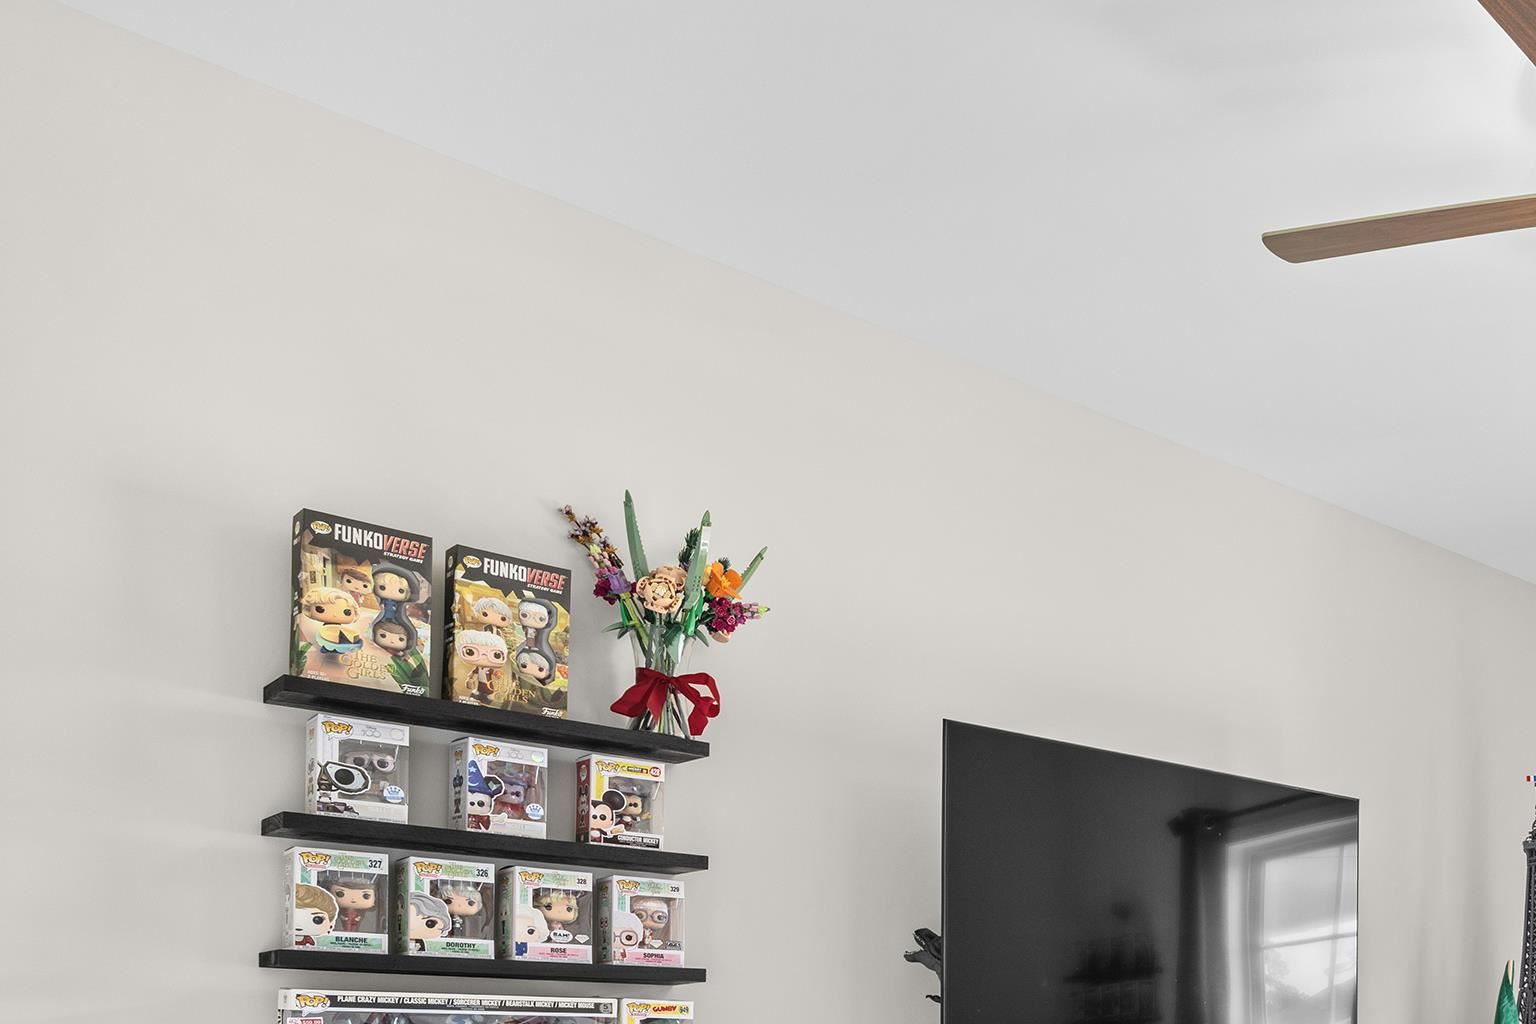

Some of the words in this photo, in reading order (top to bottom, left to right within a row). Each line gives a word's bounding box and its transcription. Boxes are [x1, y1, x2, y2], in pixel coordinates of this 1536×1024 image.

[334, 523, 428, 559] FUNKOVERSE
[384, 551, 409, 561] STRATEGY
[483, 557, 567, 590] FUNKOVERSE
[355, 649, 376, 663] THE
[339, 654, 396, 675] GOLDEN
[346, 666, 386, 680] GIRLS
[401, 684, 425, 695] Funko
[542, 706, 562, 718] Funko
[322, 720, 353, 735] POP!
[472, 743, 500, 757] POP!
[595, 760, 620, 772] POP!
[300, 851, 331, 866] POP!
[368, 859, 382, 869] 327
[414, 861, 442, 876] POP!
[476, 869, 489, 878] 326
[519, 871, 544, 884] POP!
[616, 879, 640, 892] POP!
[335, 936, 368, 944] BLANCHE
[445, 941, 476, 949] DOROTHY
[296, 994, 329, 1009] POP!
[337, 995, 356, 1003] PLANE
[357, 996, 376, 1004] CRAZY
[404, 997, 427, 1005] CLASSIC
[453, 998, 480, 1006] SORCERER
[627, 1002, 651, 1013] POP!
